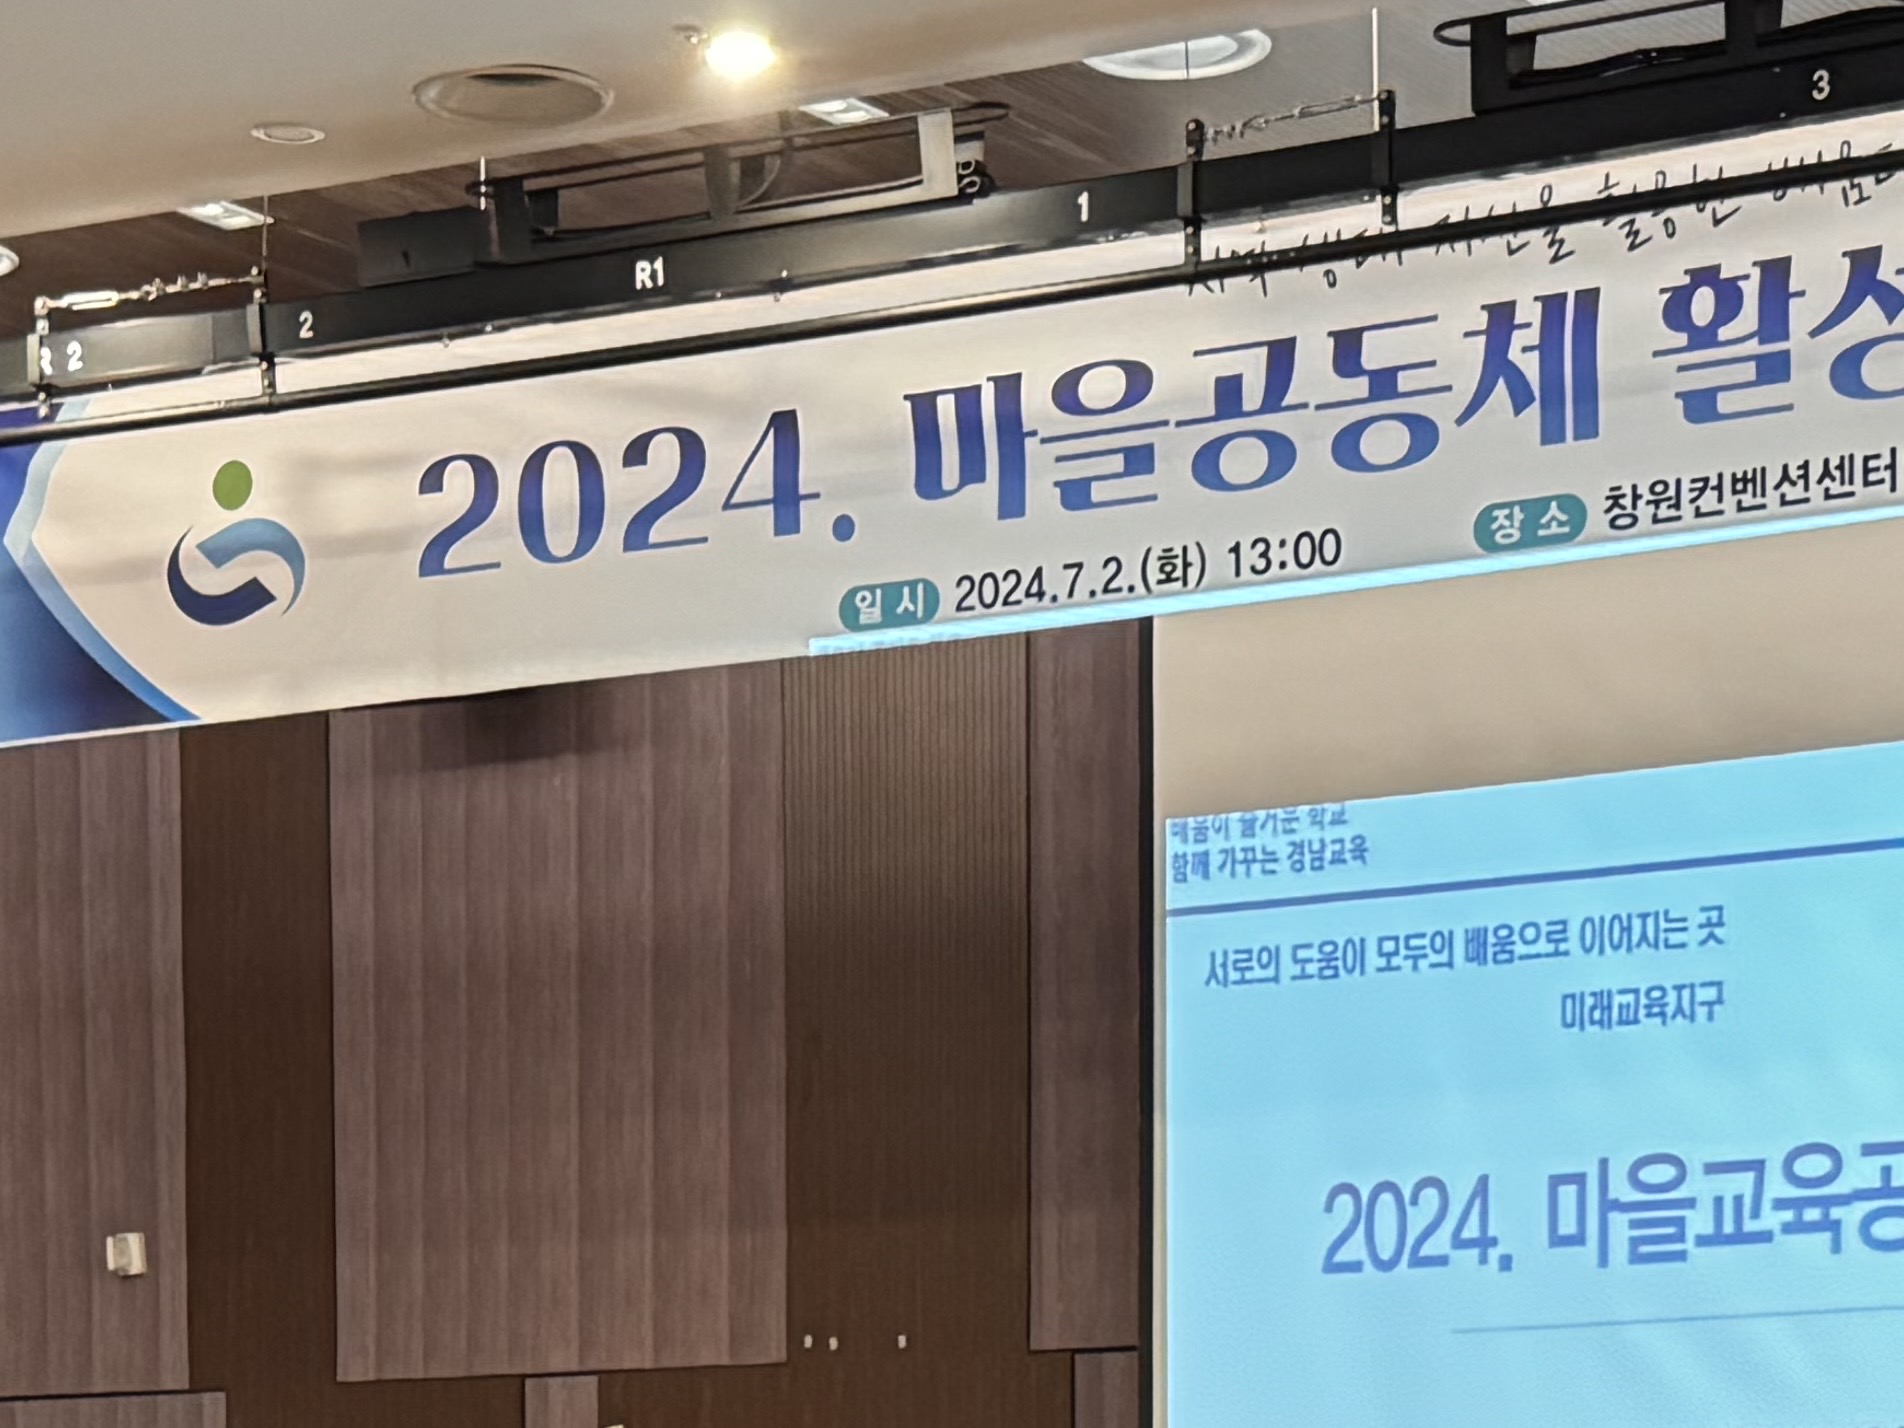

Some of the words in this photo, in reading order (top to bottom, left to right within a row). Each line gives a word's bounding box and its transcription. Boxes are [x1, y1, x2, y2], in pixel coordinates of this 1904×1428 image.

[1811, 69, 1831, 101] 3
[1077, 191, 1090, 223] 1
[635, 255, 665, 290] R1
[298, 310, 314, 339] 2
[418, 408, 856, 578] 2024.
[903, 286, 1601, 520] 마을공동체
[954, 540, 1207, 613] 2024.7.2.(화)
[1226, 526, 1343, 579] 13:00
[1171, 849, 1211, 884] 함께
[1217, 844, 1280, 879] 가꾸는
[1286, 833, 1370, 874] 경남교육
[1204, 944, 1282, 988] 서로의
[1289, 937, 1367, 982] 도움이
[1376, 929, 1455, 975] 모두의
[1464, 919, 1571, 967] 배움으로
[1579, 908, 1689, 956] 이어지는
[1697, 904, 1727, 948] 곳
[1560, 980, 1726, 1032] 미래교육지구
[1321, 1173, 1514, 1275] 2024.
